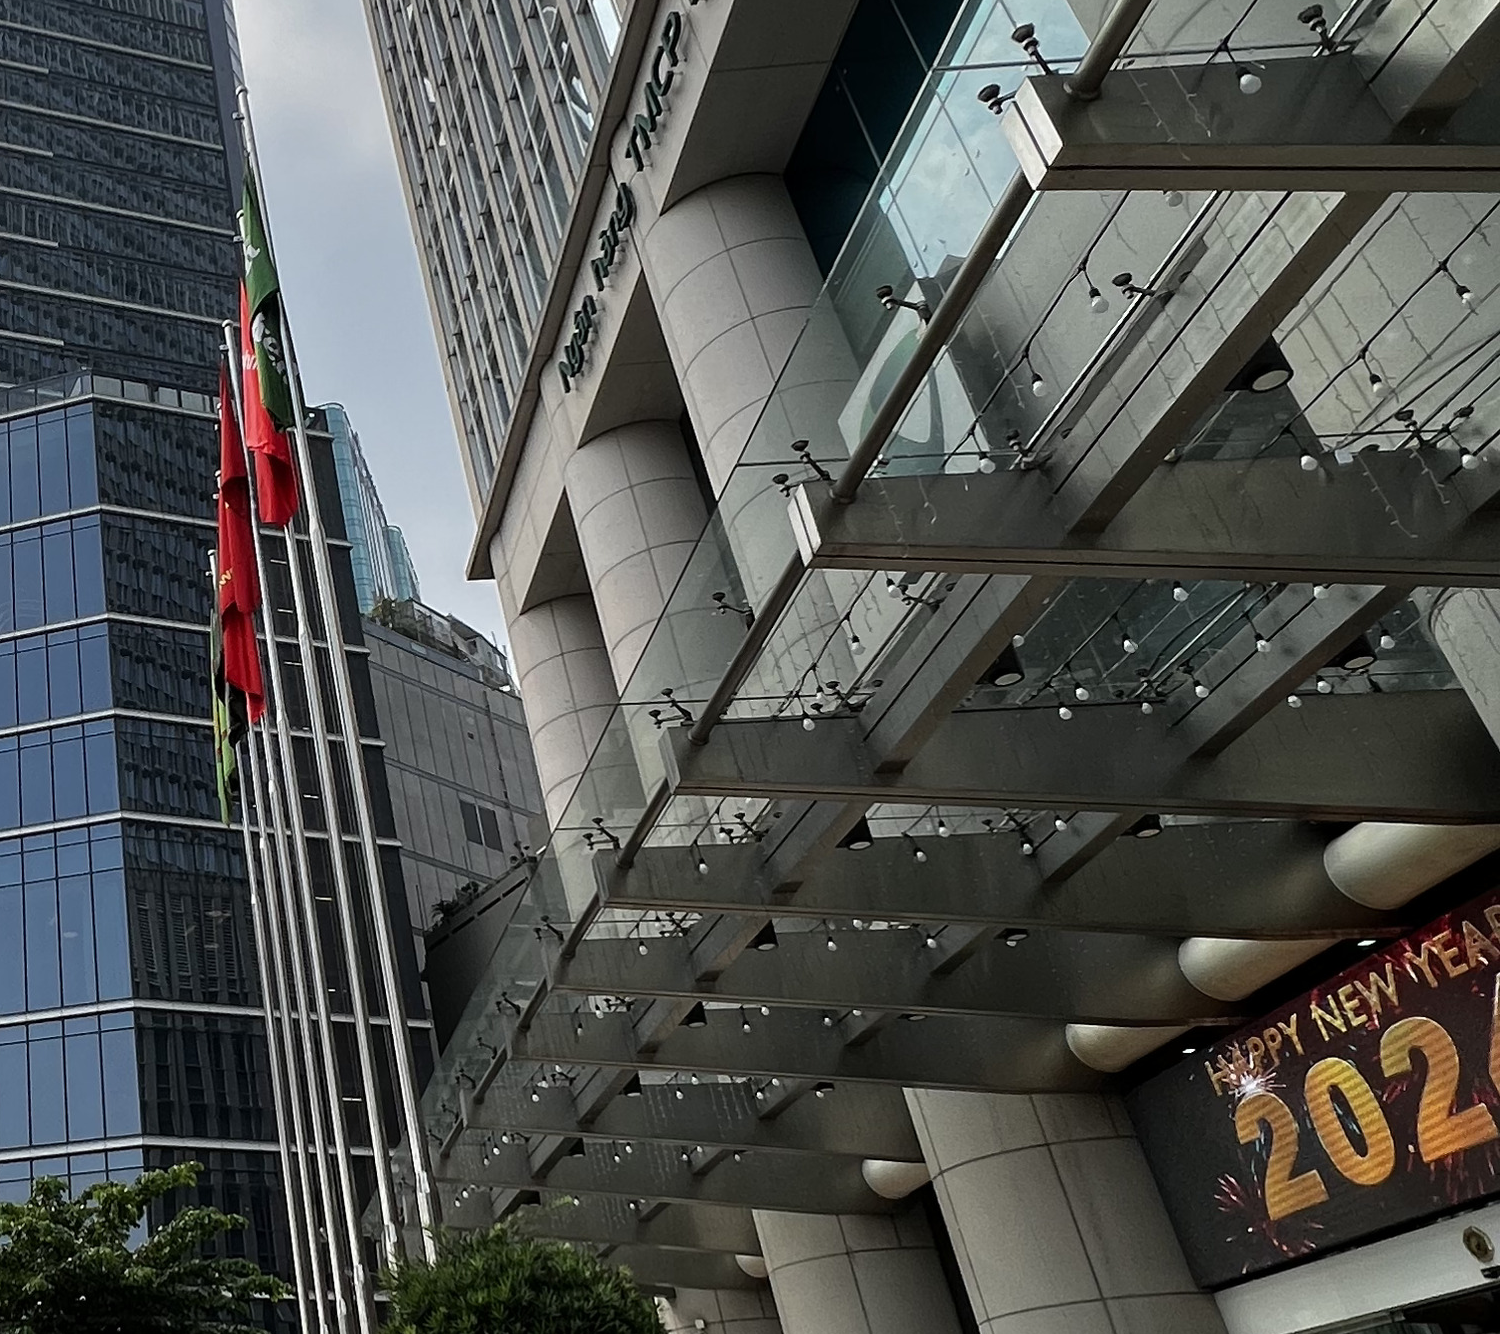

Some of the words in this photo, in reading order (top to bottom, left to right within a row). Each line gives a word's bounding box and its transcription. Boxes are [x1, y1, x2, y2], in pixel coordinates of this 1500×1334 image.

[625, 10, 681, 173] TMCP
[1204, 1013, 1305, 1097] HAPPY
[1310, 962, 1400, 1042] NEW
[1235, 972, 1500, 1220] 202
